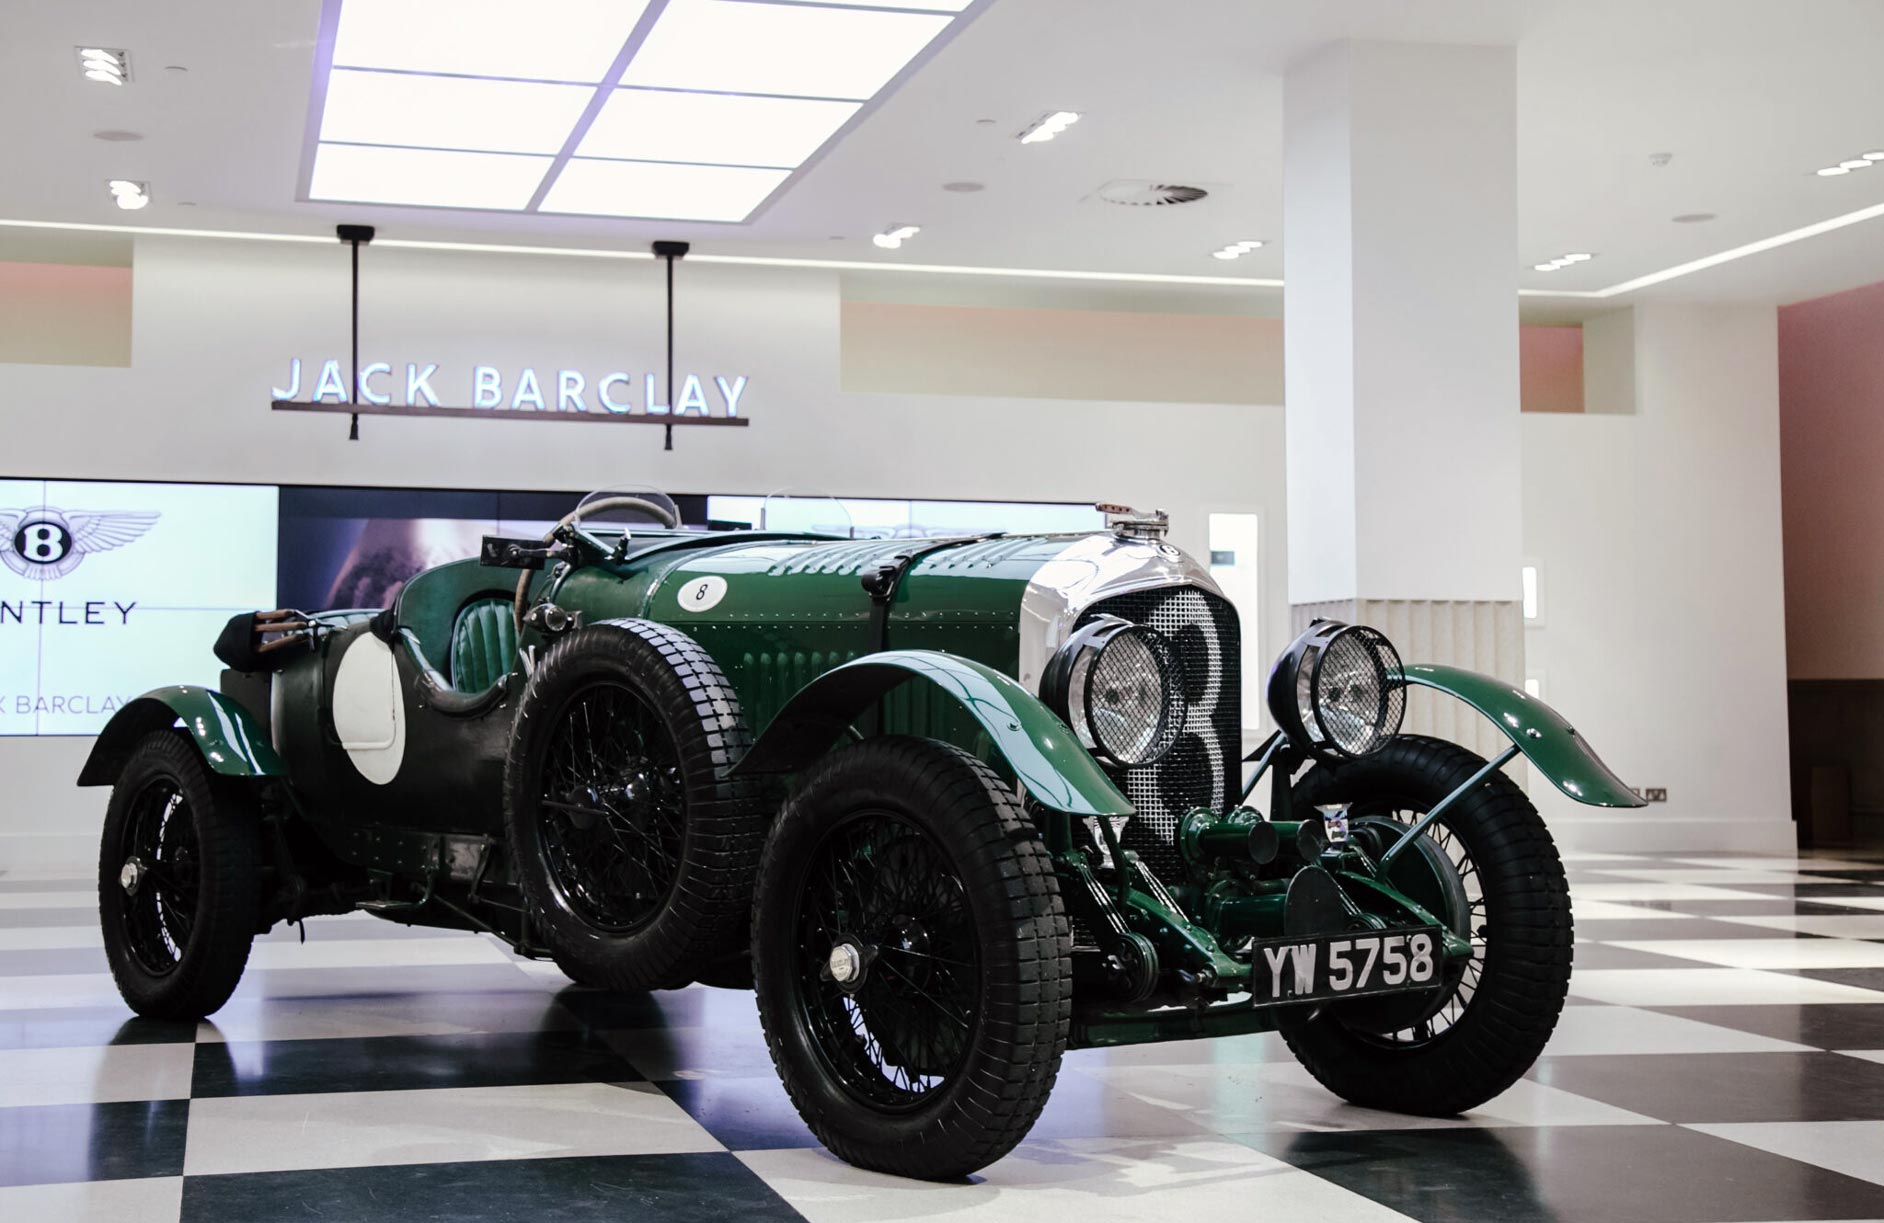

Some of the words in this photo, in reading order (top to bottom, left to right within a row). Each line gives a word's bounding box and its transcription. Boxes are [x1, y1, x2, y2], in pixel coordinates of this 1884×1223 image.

[272, 358, 442, 406] JACK
[473, 365, 749, 418] BARCLAY
[0, 601, 136, 624] NTLEY
[695, 584, 709, 601] 8
[1263, 943, 1317, 998] YW
[1329, 933, 1434, 991] 5758
